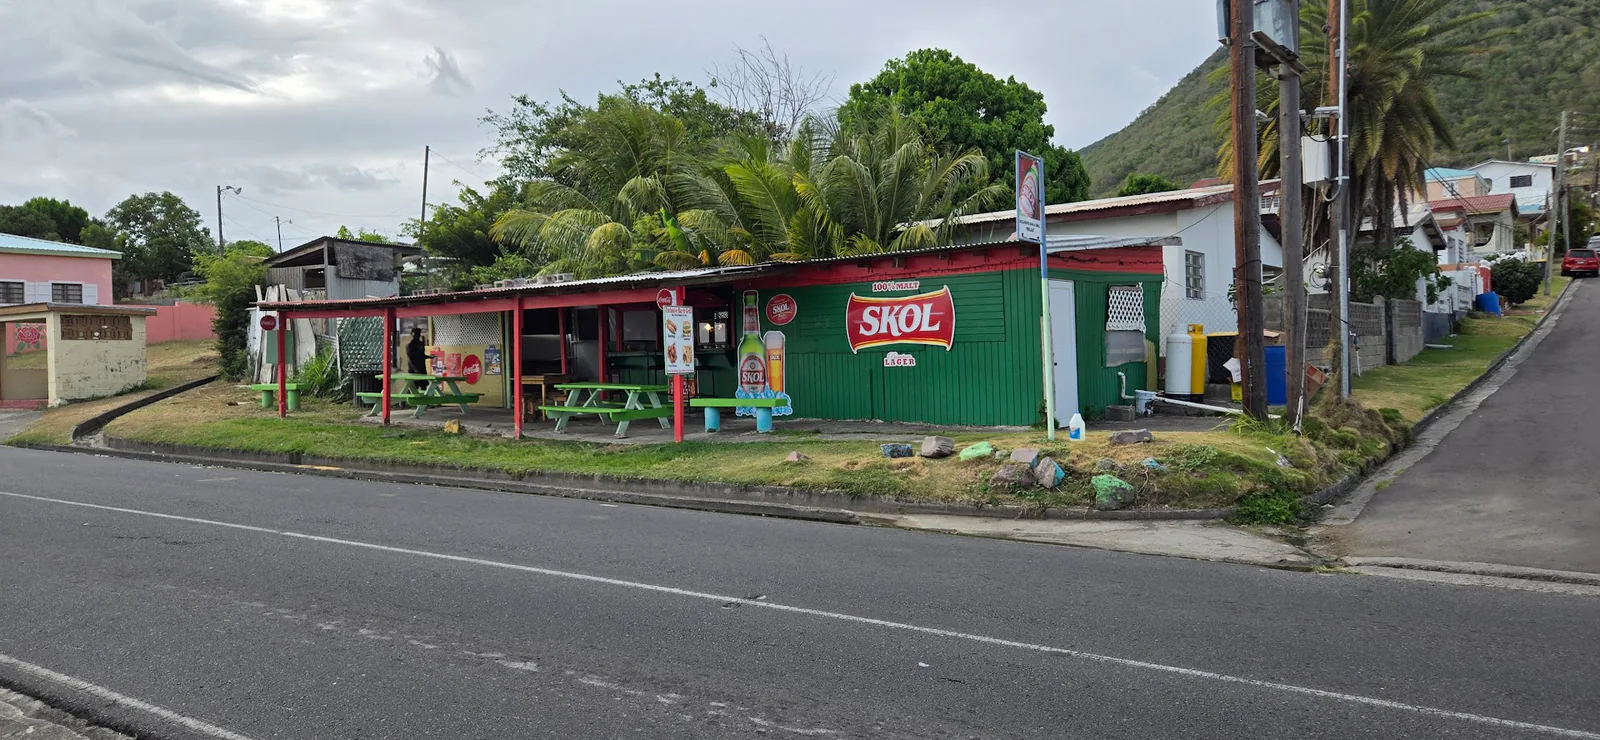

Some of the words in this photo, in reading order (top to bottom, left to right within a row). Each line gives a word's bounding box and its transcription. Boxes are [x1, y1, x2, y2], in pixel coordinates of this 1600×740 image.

[873, 282, 895, 291] 100%
[896, 282, 919, 290] MALT
[772, 304, 790, 314] SKOL
[859, 303, 941, 337] SKOL
[742, 372, 764, 383] SKOL
